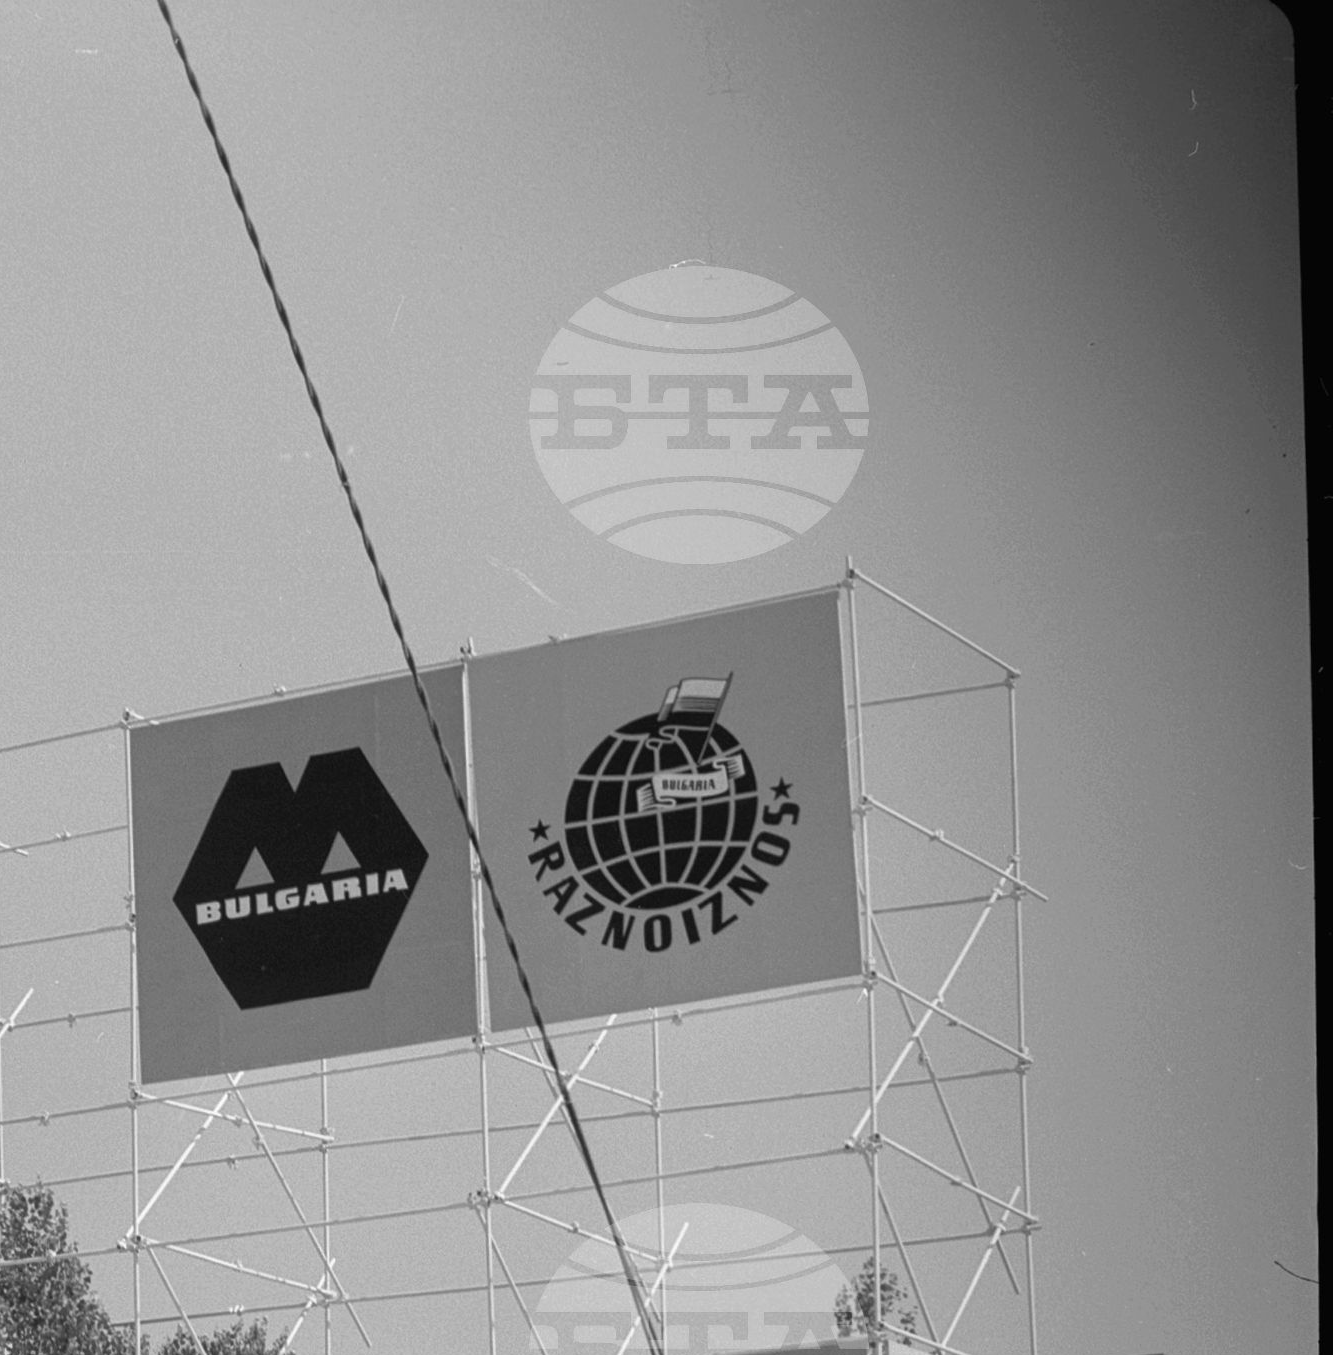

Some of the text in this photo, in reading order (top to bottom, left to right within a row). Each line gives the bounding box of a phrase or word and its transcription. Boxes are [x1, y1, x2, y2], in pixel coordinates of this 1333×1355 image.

[662, 778, 716, 791] BULGARIA
[195, 867, 409, 925] BULGARIA
[528, 801, 801, 952] RAZNOIZNOS
